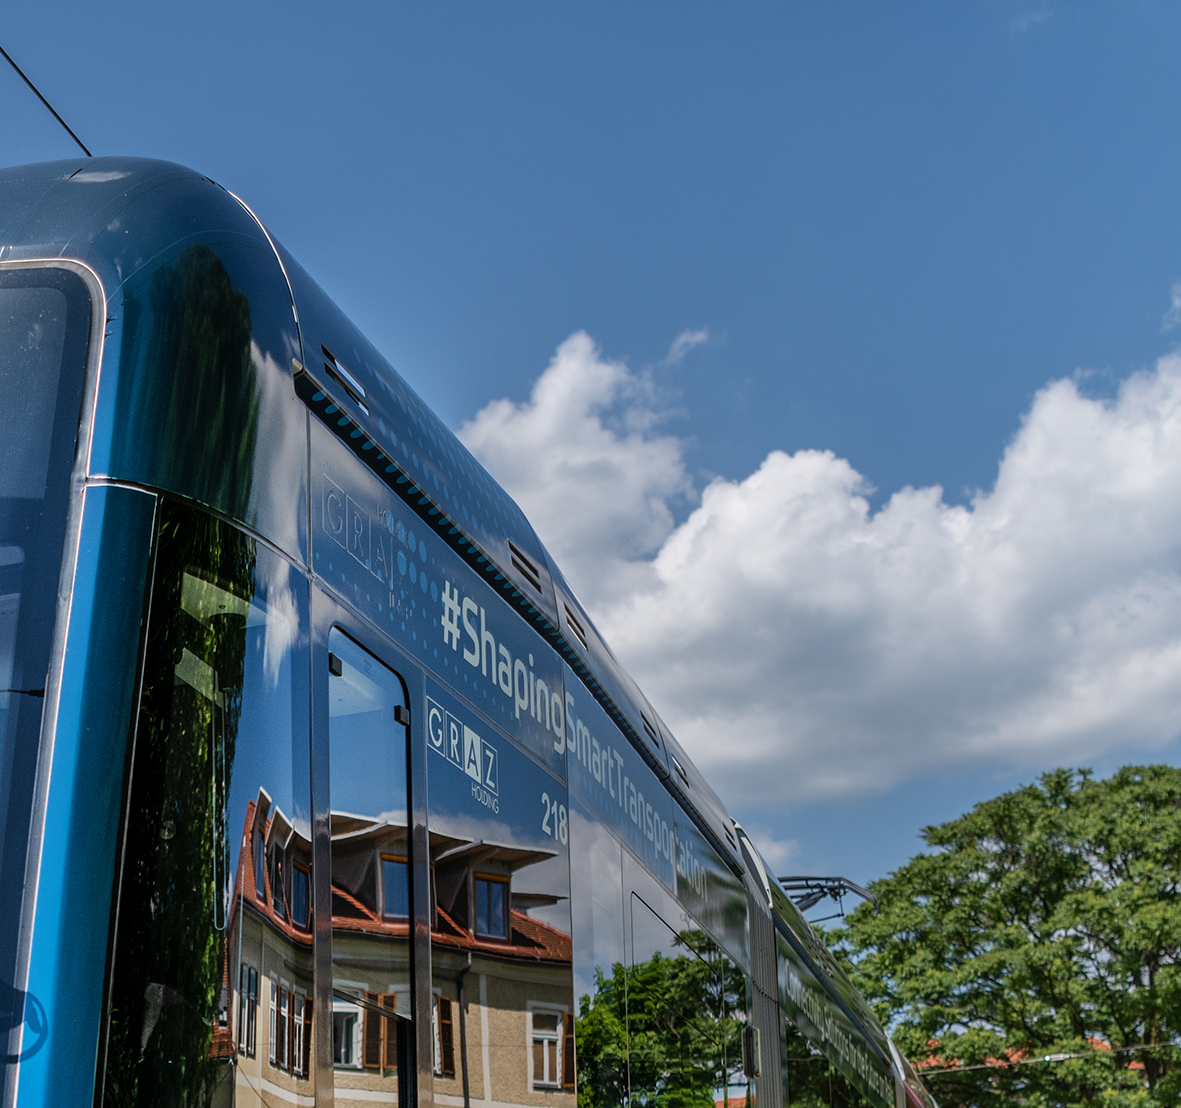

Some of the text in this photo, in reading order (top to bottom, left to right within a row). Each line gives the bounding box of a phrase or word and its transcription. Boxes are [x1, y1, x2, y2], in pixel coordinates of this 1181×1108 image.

[428, 698, 499, 794] GRAZ
[471, 781, 500, 815] HOLDING
[540, 792, 568, 847] 218
